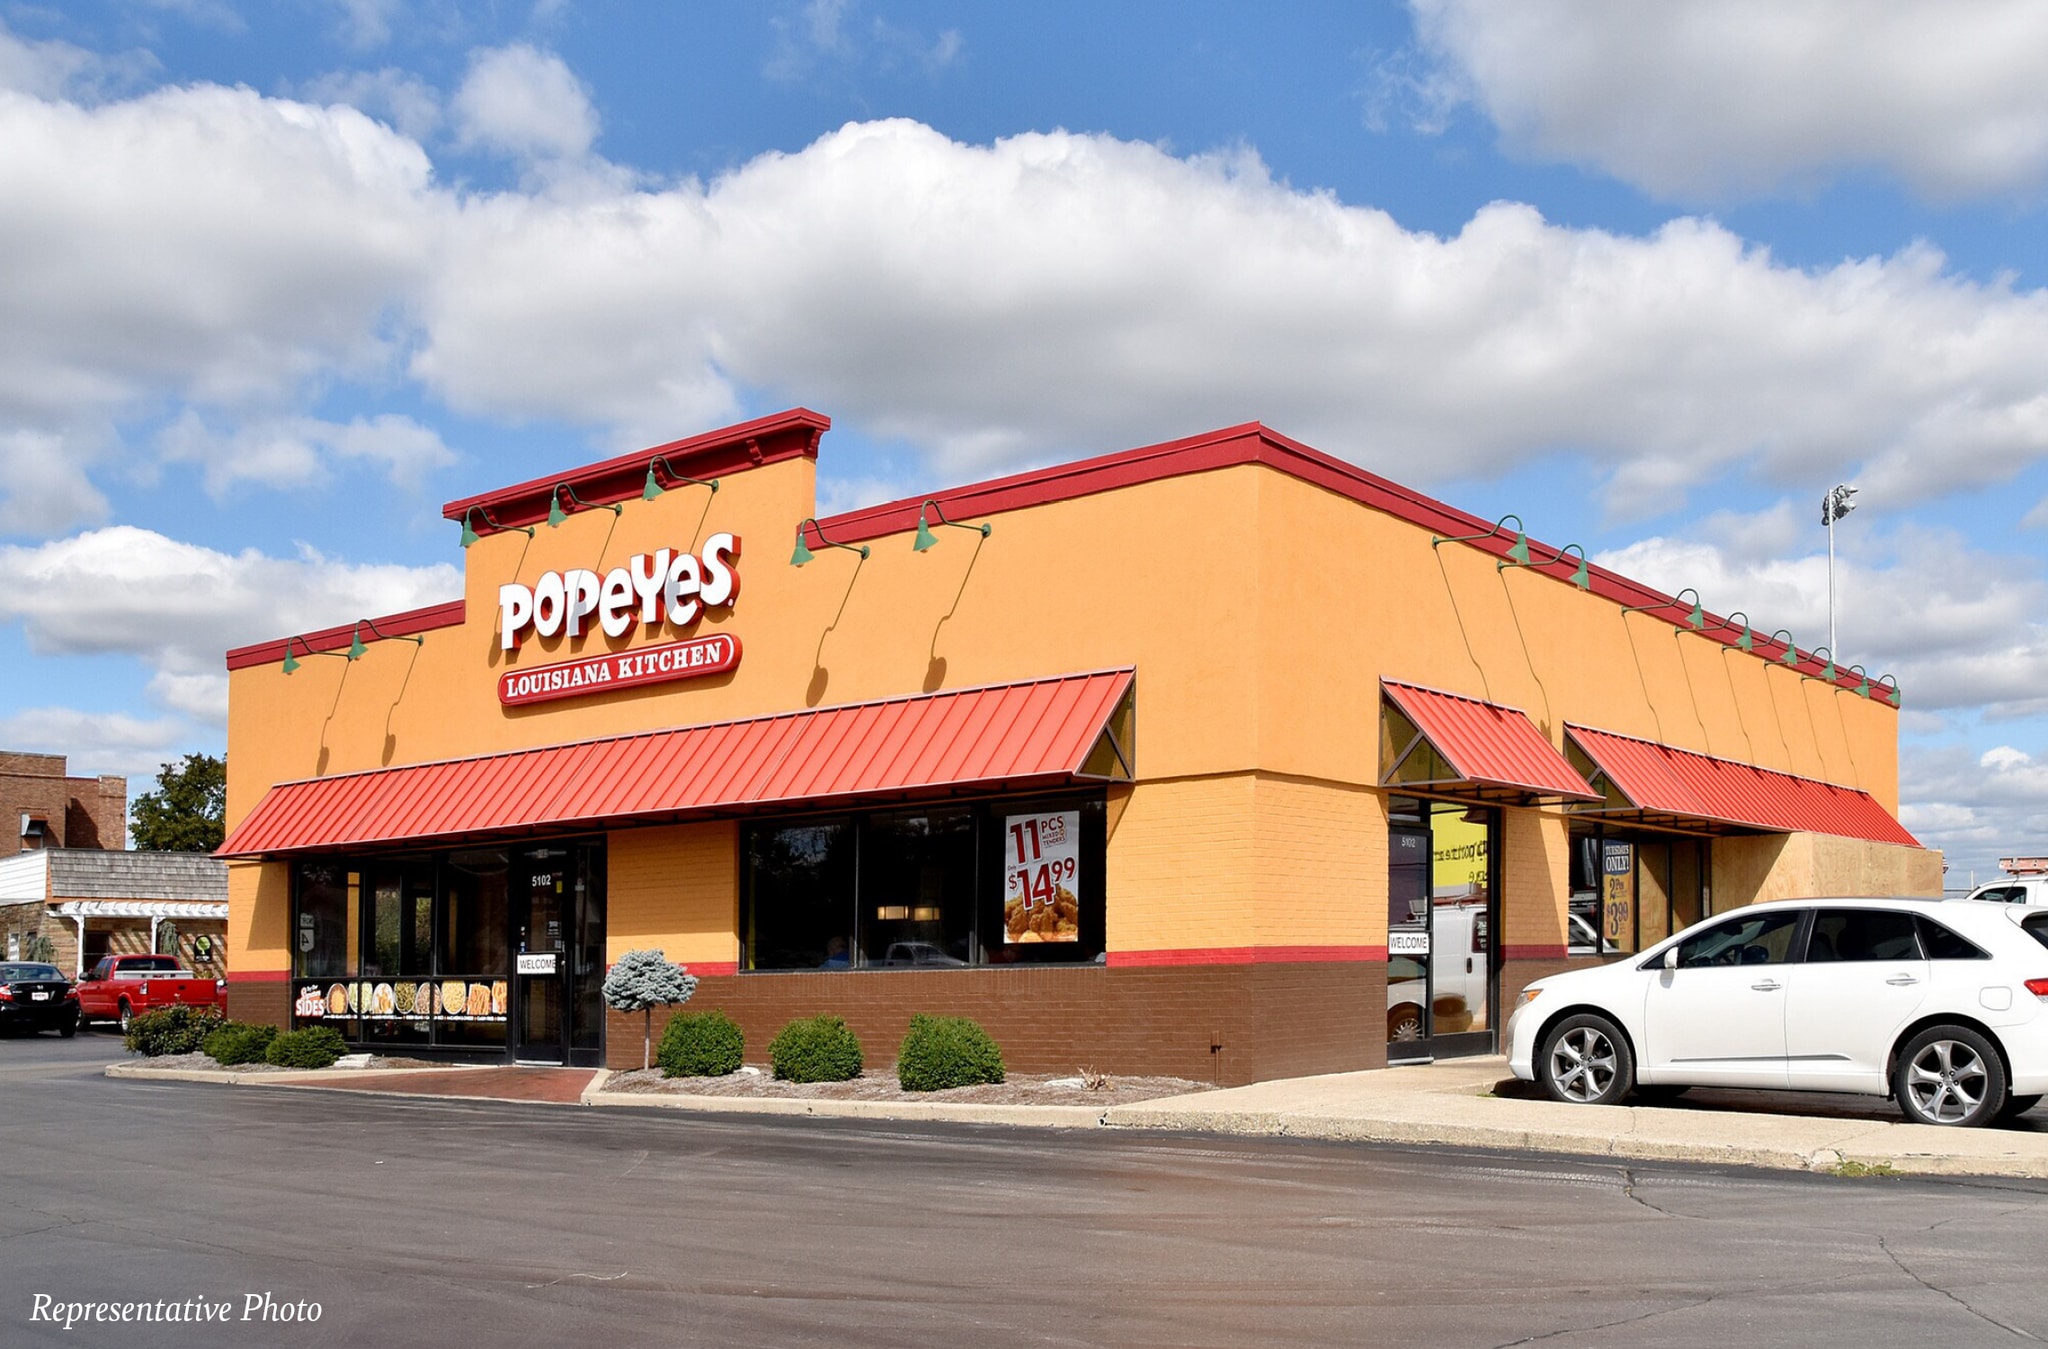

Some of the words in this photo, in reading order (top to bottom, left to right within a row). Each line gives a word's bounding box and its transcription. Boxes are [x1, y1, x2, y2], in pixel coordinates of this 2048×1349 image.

[506, 663, 612, 698] LOUISIANA
[617, 641, 723, 679] KITCHEN
[1010, 818, 1042, 865] 11
[1041, 815, 1065, 833] PCS
[1401, 836, 1416, 848] 5102
[1605, 855, 1630, 872] ONLY!
[531, 874, 551, 887] 5102
[1390, 936, 1428, 949] WELCOME
[519, 958, 556, 970] WELCOME
[295, 998, 325, 1017] SIDES
